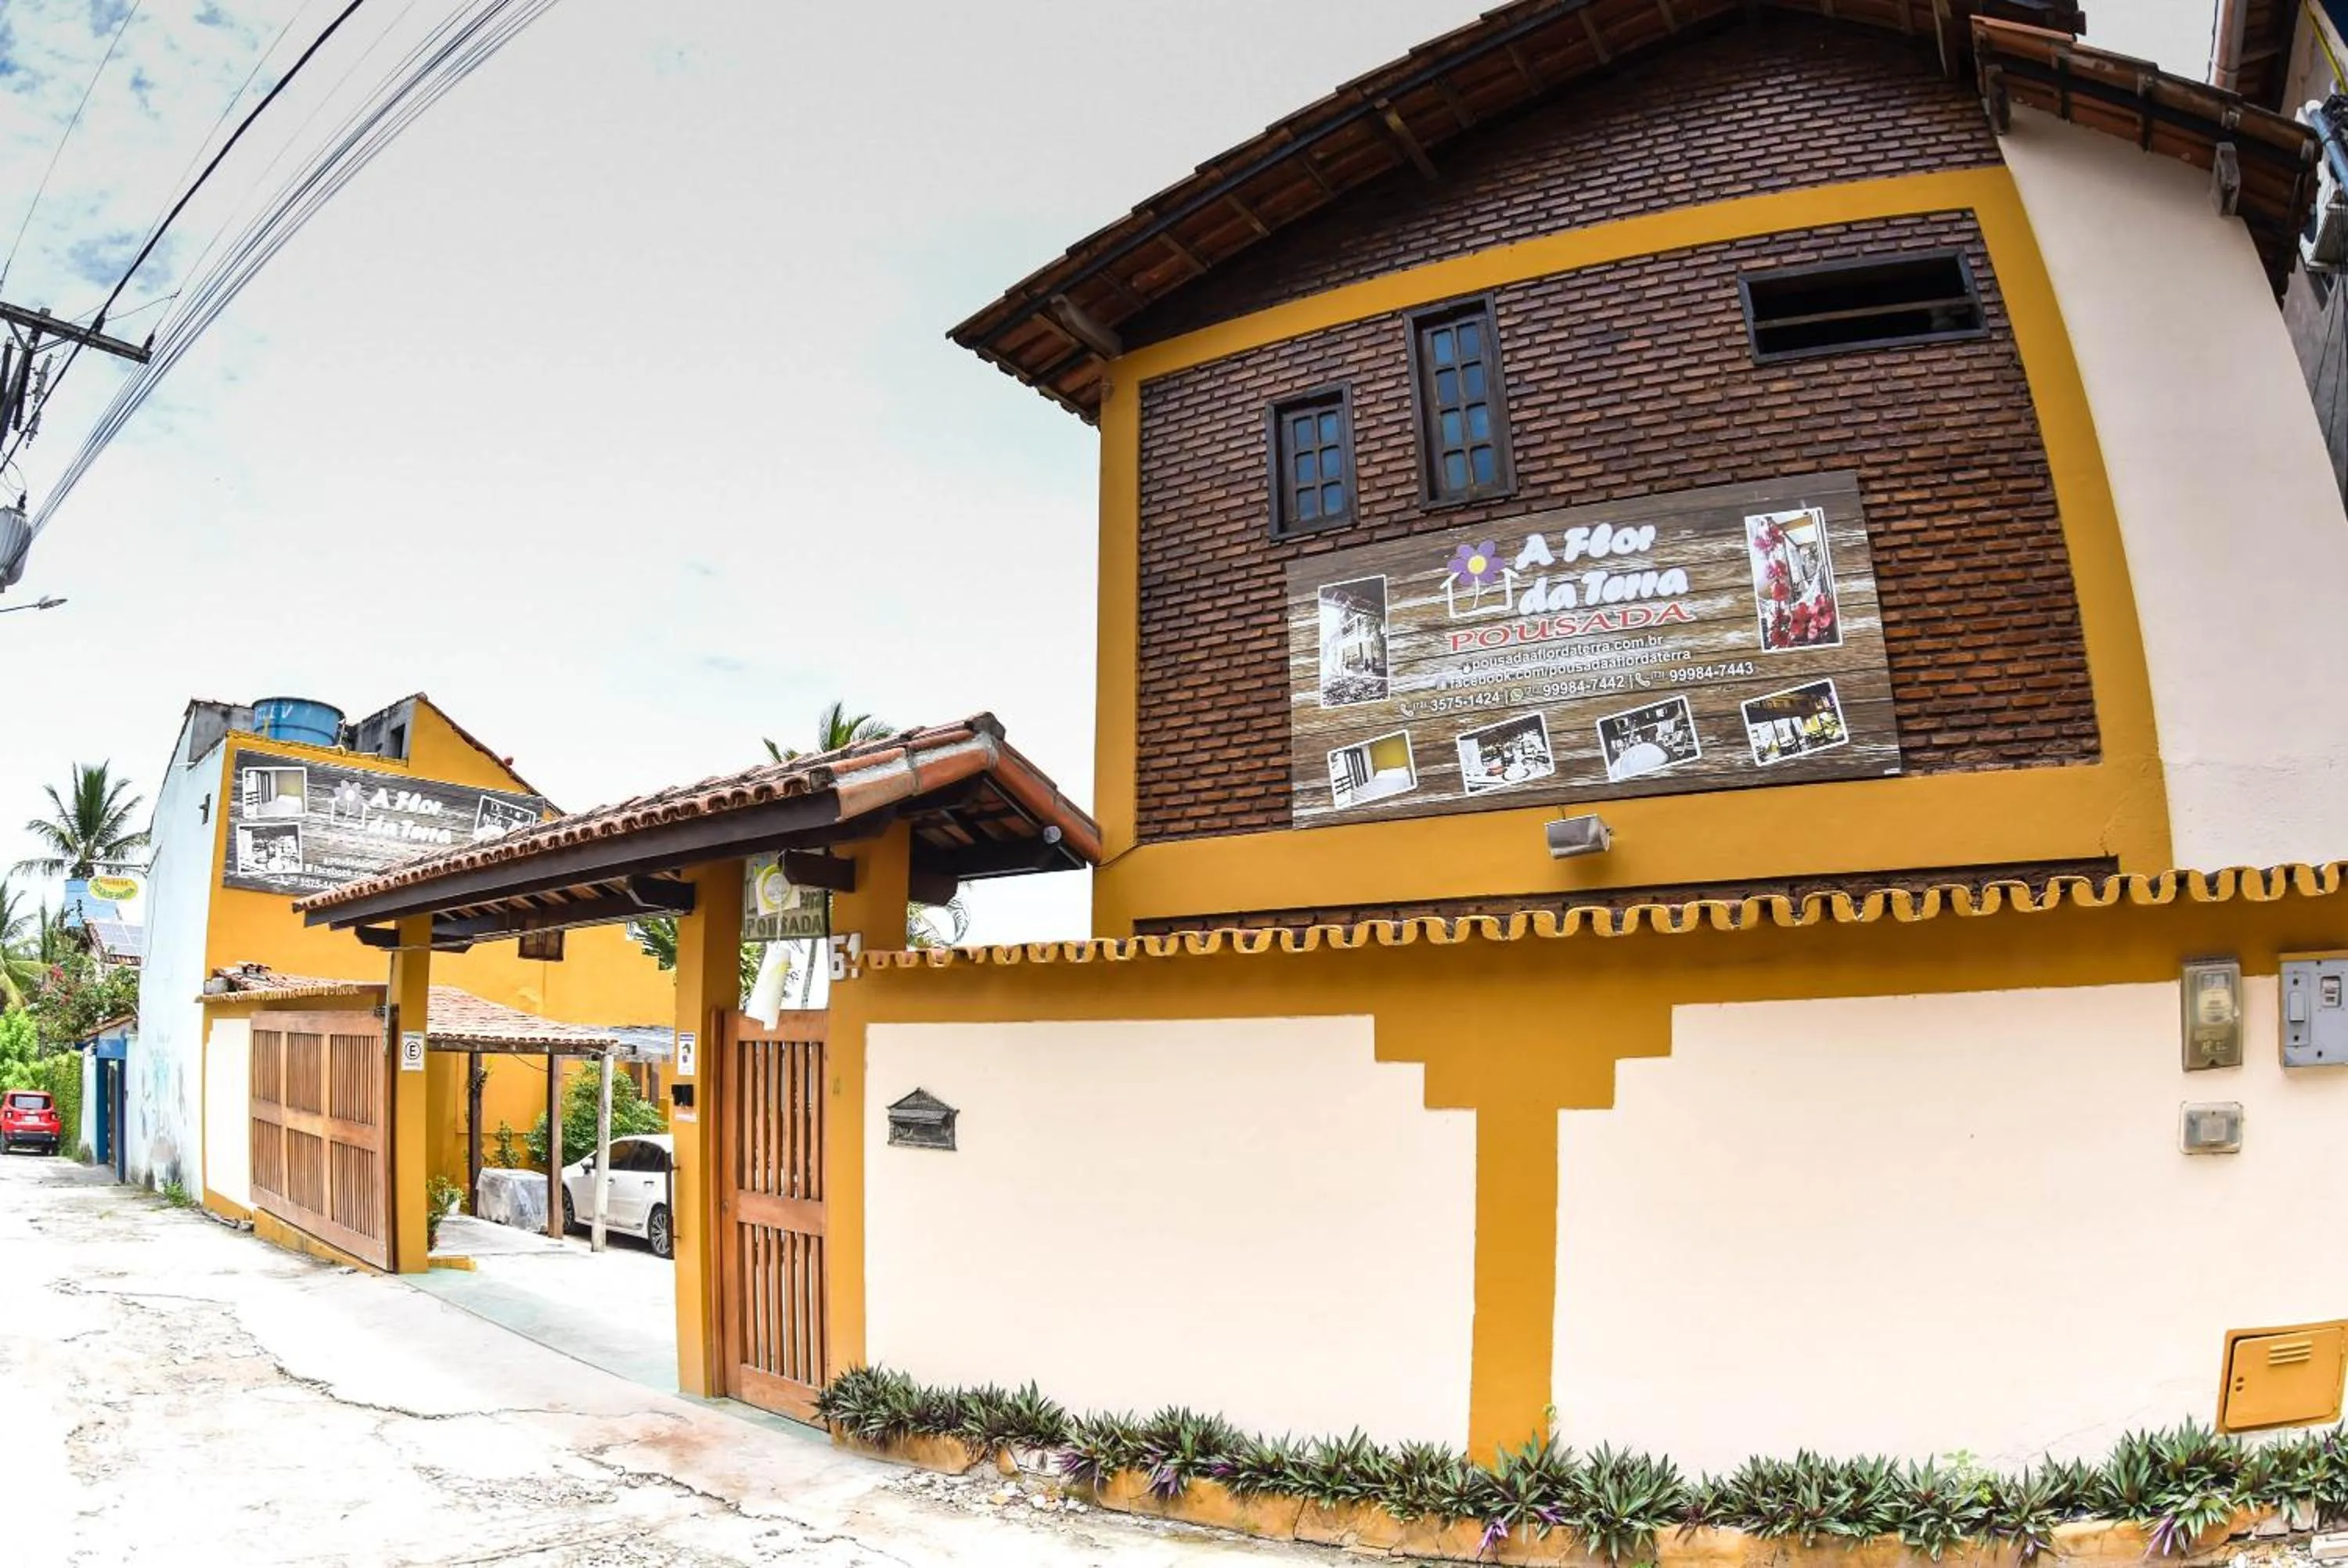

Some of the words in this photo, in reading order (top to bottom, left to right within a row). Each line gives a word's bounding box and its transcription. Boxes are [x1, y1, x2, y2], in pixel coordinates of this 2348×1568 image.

[1514, 533, 1554, 570] A
[1564, 523, 1656, 563] Flor
[1518, 577, 1578, 615] da
[1582, 568, 1689, 606] Terra
[1450, 602, 1694, 651] POUSADA
[1430, 692, 1500, 711] 3575-1424
[1543, 675, 1625, 696] 99984-7442
[1670, 662, 1754, 682] 99984-7443
[369, 788, 391, 809] A
[394, 791, 442, 815] Flor
[746, 915, 822, 936] POUSADA
[409, 1045, 416, 1056] E
